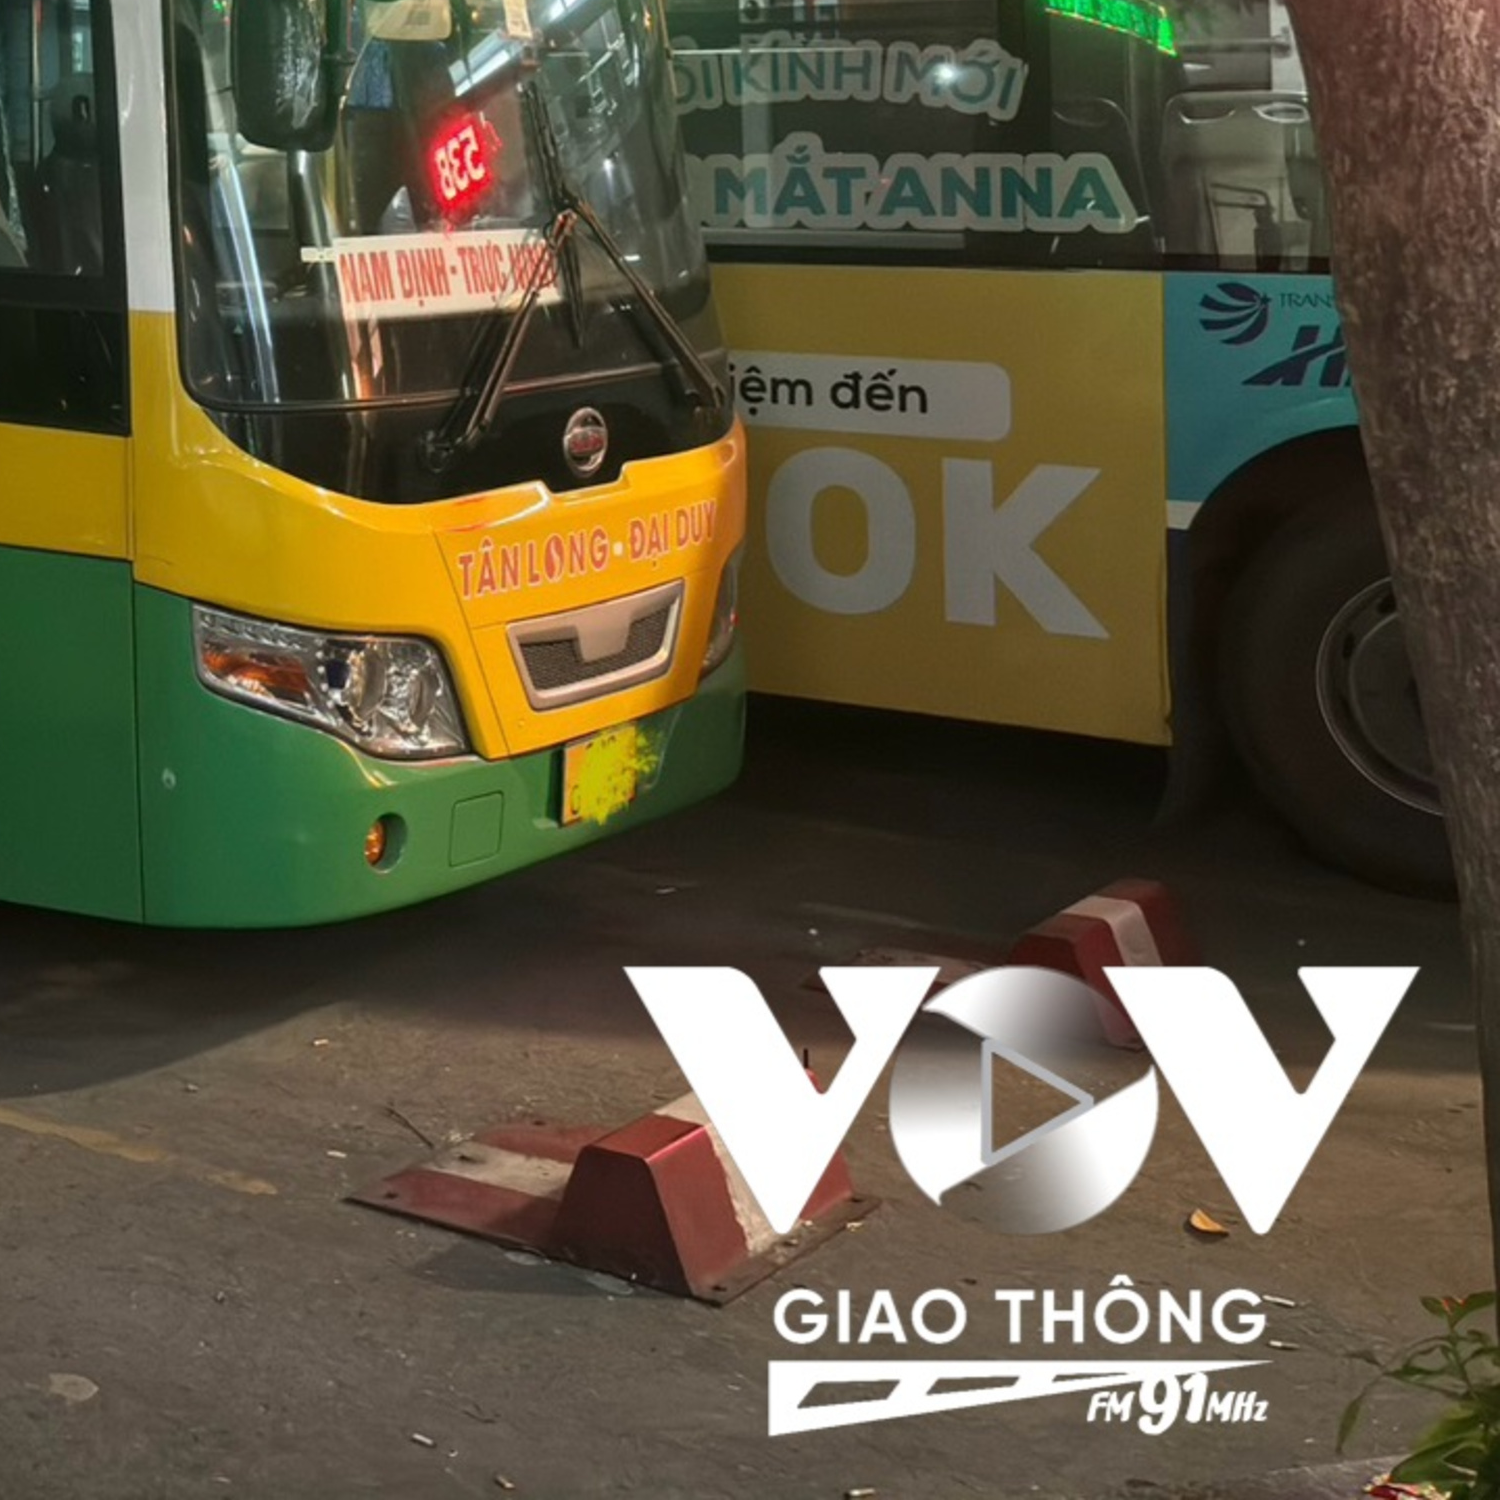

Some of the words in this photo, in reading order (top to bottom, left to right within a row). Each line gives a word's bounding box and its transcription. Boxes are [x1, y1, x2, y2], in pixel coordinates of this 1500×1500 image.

[714, 143, 867, 217] MẮT
[879, 165, 1122, 220] ANNA
[340, 251, 395, 303] NAM
[396, 247, 450, 308] ĐỊNH
[829, 367, 928, 415] đến
[630, 513, 669, 568] ĐẠI
[676, 499, 718, 548] DUY
[764, 445, 1111, 641] OK
